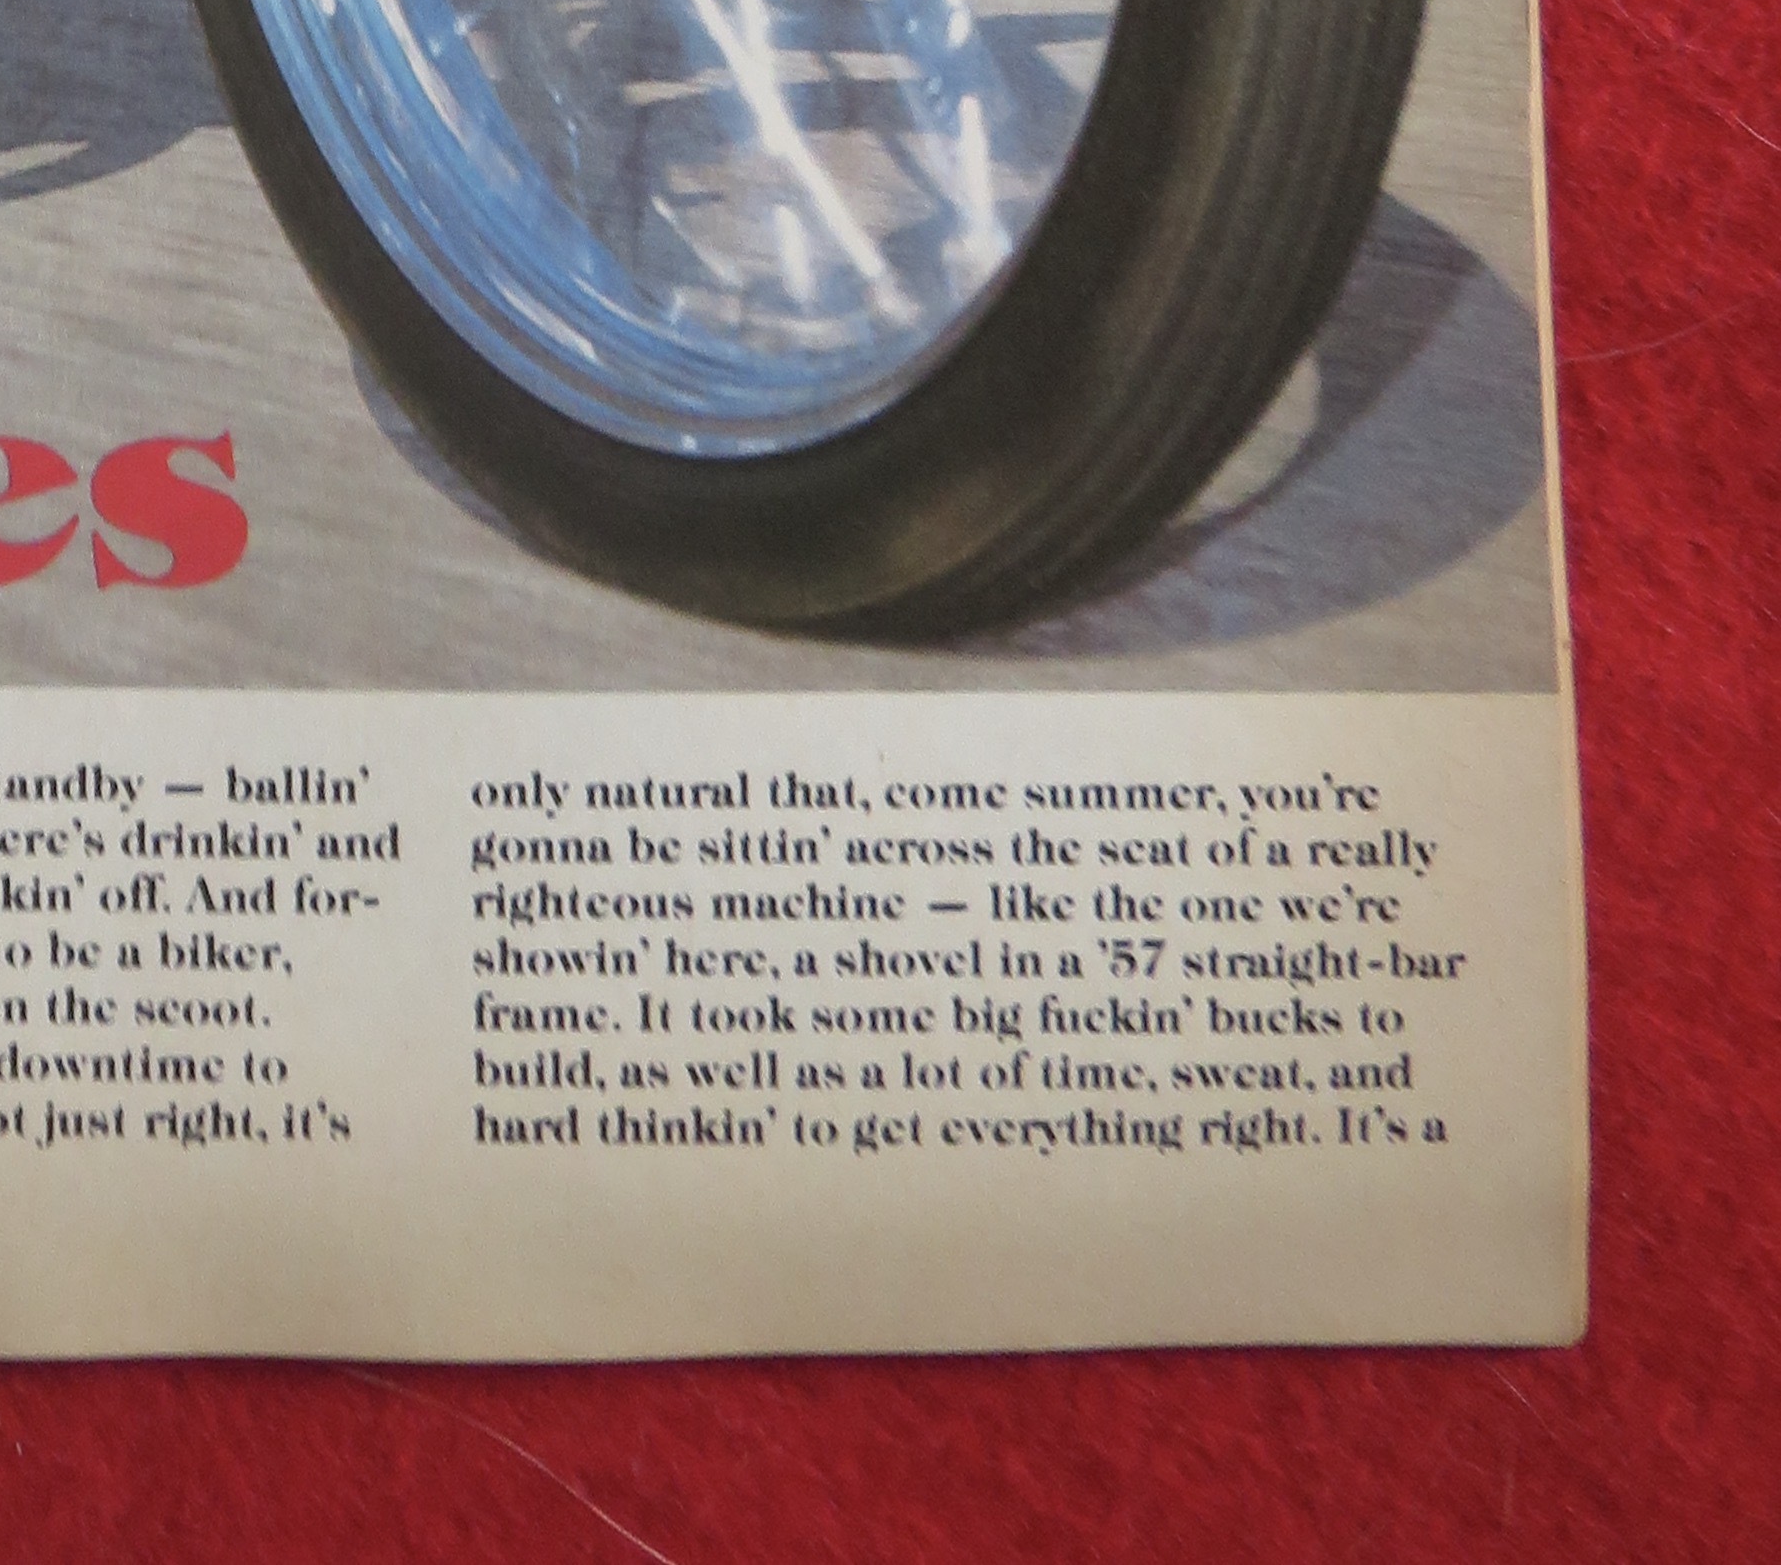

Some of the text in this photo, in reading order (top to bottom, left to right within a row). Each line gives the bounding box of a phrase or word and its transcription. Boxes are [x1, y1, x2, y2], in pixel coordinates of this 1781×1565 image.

[226, 765, 369, 805] ballin'
[472, 770, 1379, 821] only natural that, come summer, you're
[120, 819, 302, 860] drinkin'
[317, 822, 400, 861] and
[471, 825, 1436, 877] gonna be sittin' across the seat of a really
[99, 872, 170, 914] off.
[187, 875, 276, 915] And
[295, 874, 379, 916] for-
[472, 880, 1400, 929] righteous machine like the one we're
[473, 936, 1466, 989] showin' here, a shovel in a '57 straight-bar
[244, 1050, 288, 1085] to
[474, 1048, 1413, 1094] build, as well as a lot of time, sweat, and
[35, 1100, 124, 1149] just
[146, 1099, 268, 1149] right,
[283, 1100, 351, 1141] it's
[474, 1104, 1448, 1156] hard thinkin' to get everything right. It's a
